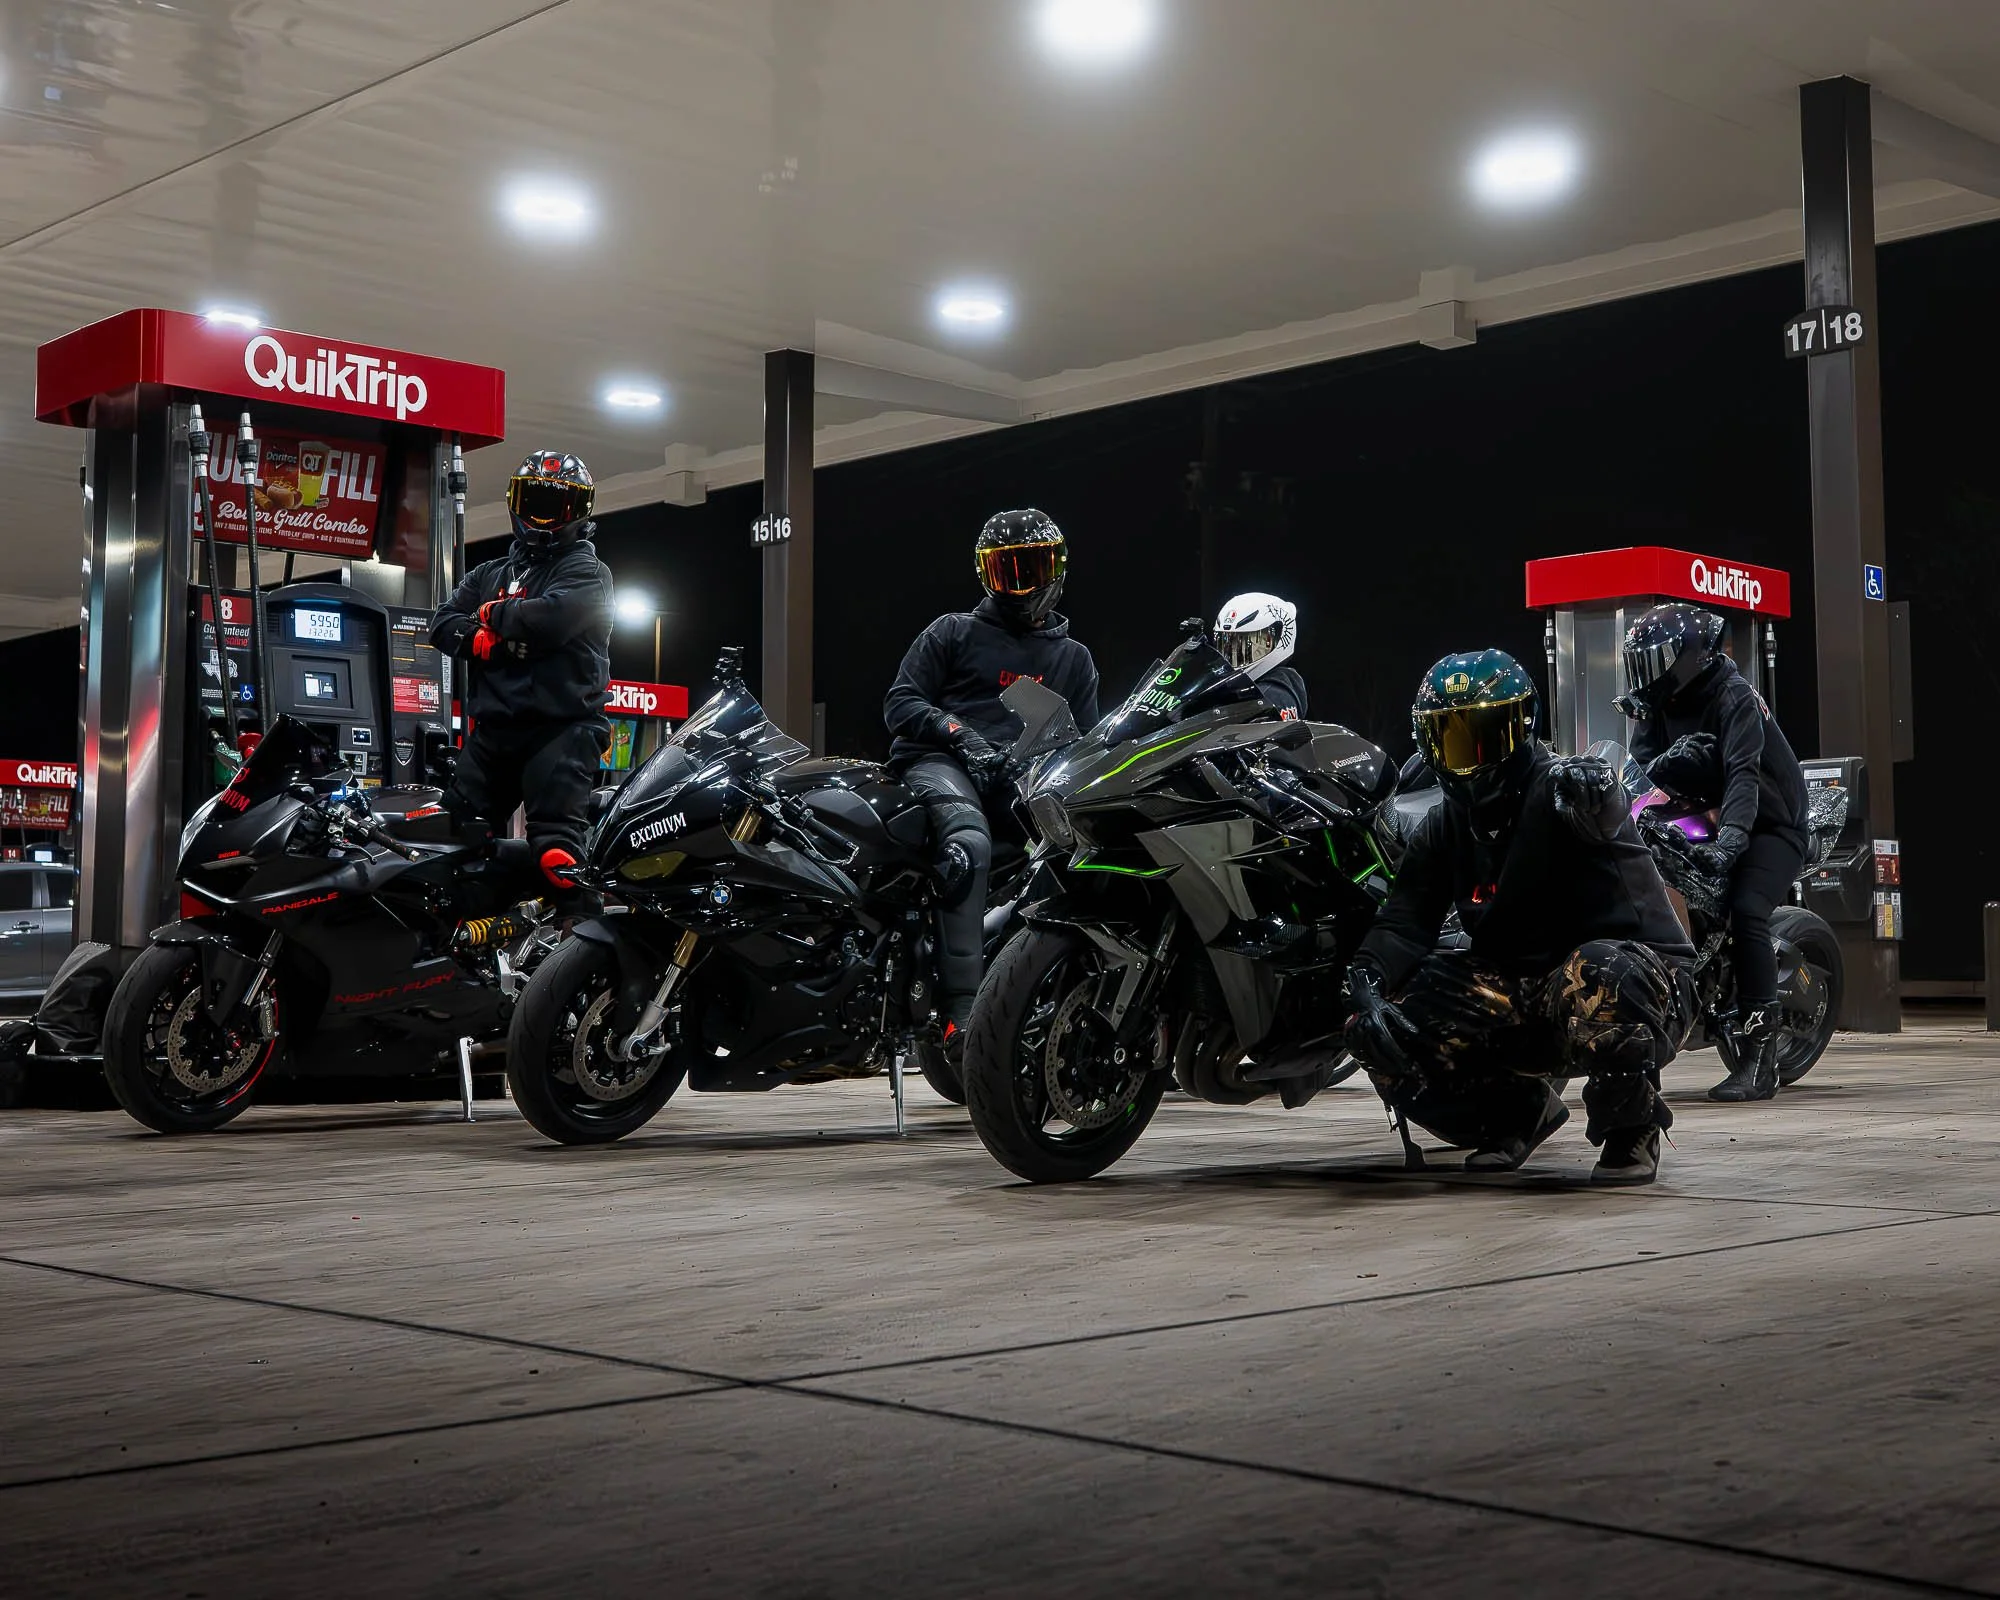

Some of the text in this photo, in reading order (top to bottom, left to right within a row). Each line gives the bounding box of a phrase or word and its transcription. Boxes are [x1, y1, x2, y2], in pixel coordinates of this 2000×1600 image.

[1787, 312, 1863, 352] 17 18
[244, 335, 428, 421] QuikTrip
[208, 432, 377, 502] ULL FILL
[266, 451, 298, 464] Doritos
[302, 453, 322, 472] QT
[217, 500, 369, 535] Roer Grill Combo
[258, 527, 273, 535] ITEMS
[752, 517, 792, 542] 15 16
[1690, 558, 1763, 610] QuikTrip
[220, 598, 233, 620] 8
[203, 623, 250, 638] Guanteed
[604, 684, 658, 715] ikTrip
[1331, 751, 1372, 769] Kawasaki
[2, 793, 28, 810] FUL
[8, 849, 16, 858] 14
[261, 892, 339, 915] PANIGALE
